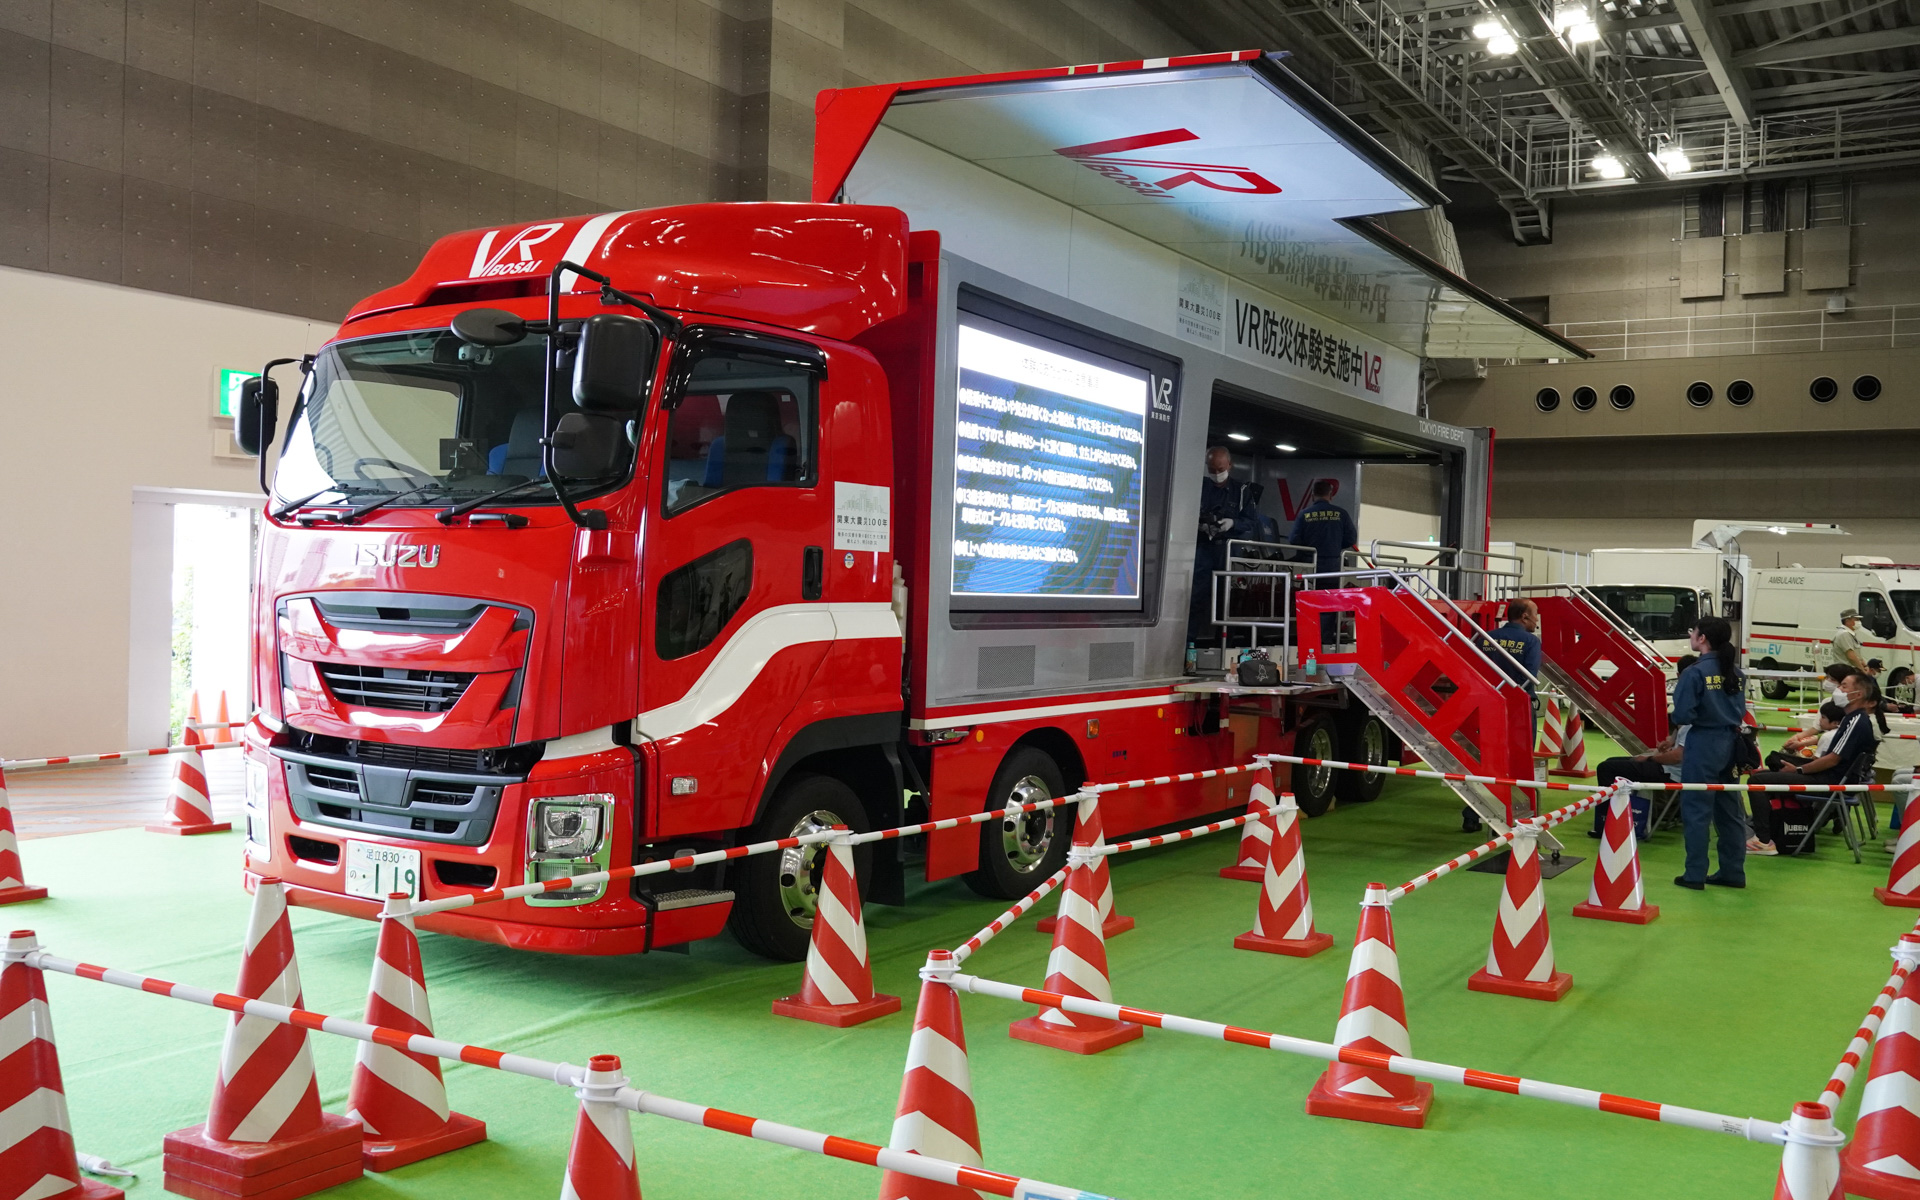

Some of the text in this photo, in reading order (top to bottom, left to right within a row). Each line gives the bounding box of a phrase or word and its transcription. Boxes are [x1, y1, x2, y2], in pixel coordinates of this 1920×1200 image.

[1053, 128, 1283, 194] VR
[469, 222, 565, 278] VR
[486, 259, 543, 277] BOSAI
[1150, 374, 1173, 409] VR
[1419, 420, 1465, 443] TOKYO FIRE DEPT.
[837, 514, 888, 527] 関東大震災100年
[351, 543, 441, 568] ISUZU
[1768, 576, 1805, 585] AMBULANCE
[1482, 638, 1525, 649] 東消防庁
[1768, 643, 1782, 656] EV
[350, 870, 357, 879] の
